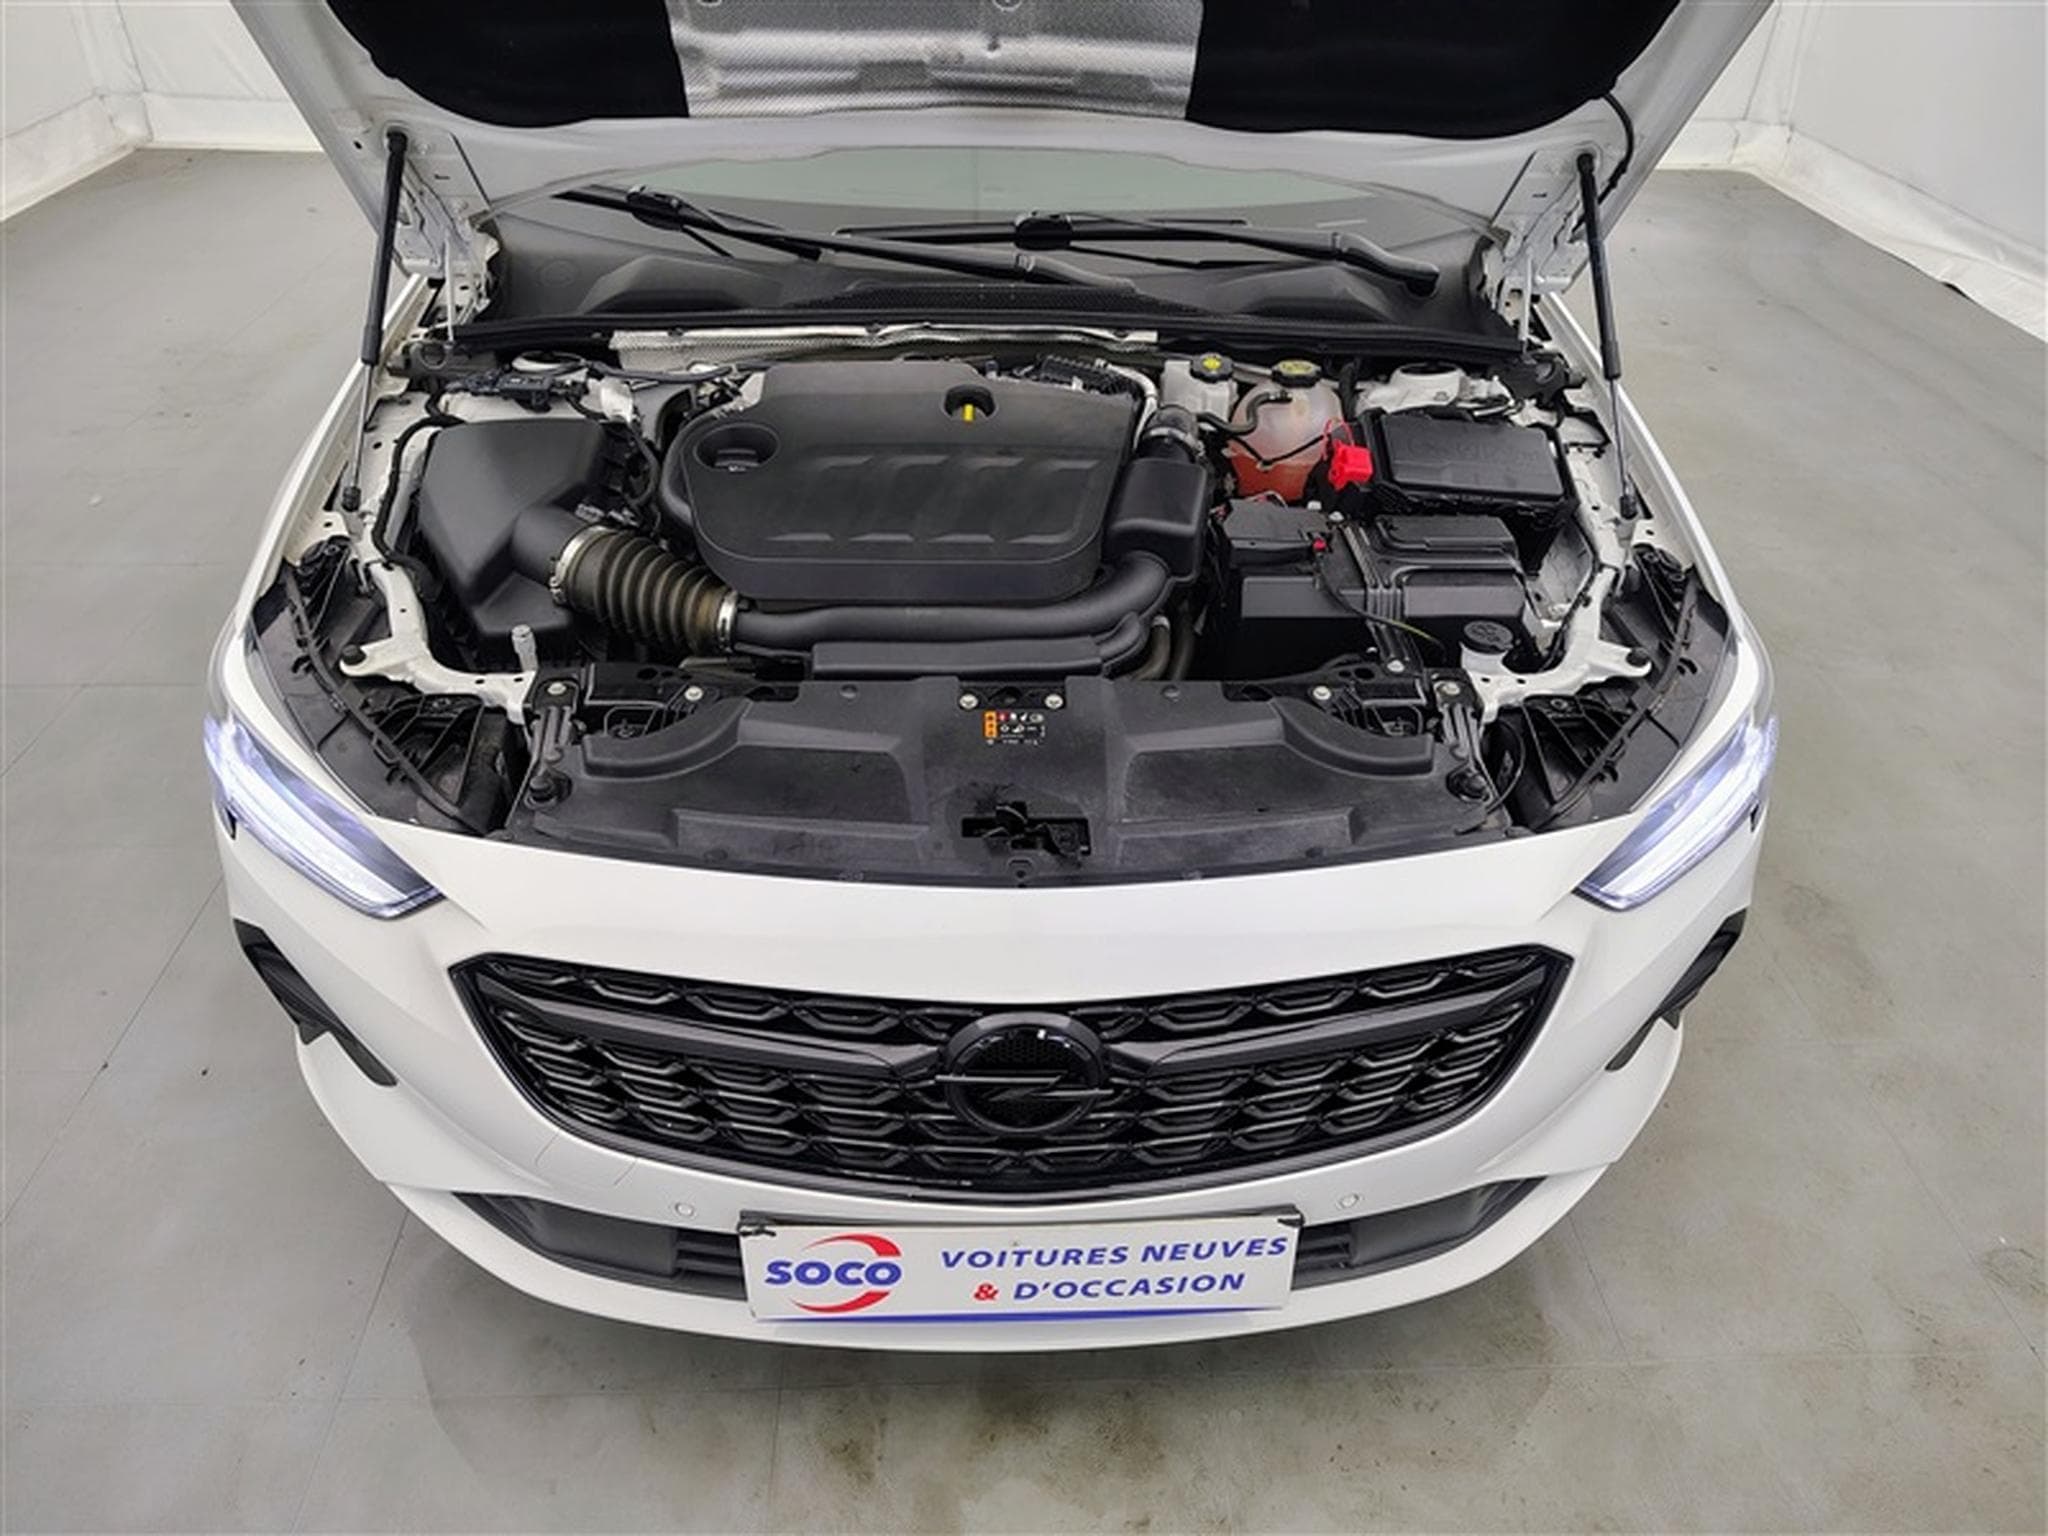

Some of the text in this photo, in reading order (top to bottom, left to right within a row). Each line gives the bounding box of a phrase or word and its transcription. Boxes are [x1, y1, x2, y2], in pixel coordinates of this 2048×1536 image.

[942, 1237, 1288, 1269] VOITURES NEUVES
[765, 1260, 902, 1286] SOCO
[973, 1282, 999, 1302] &
